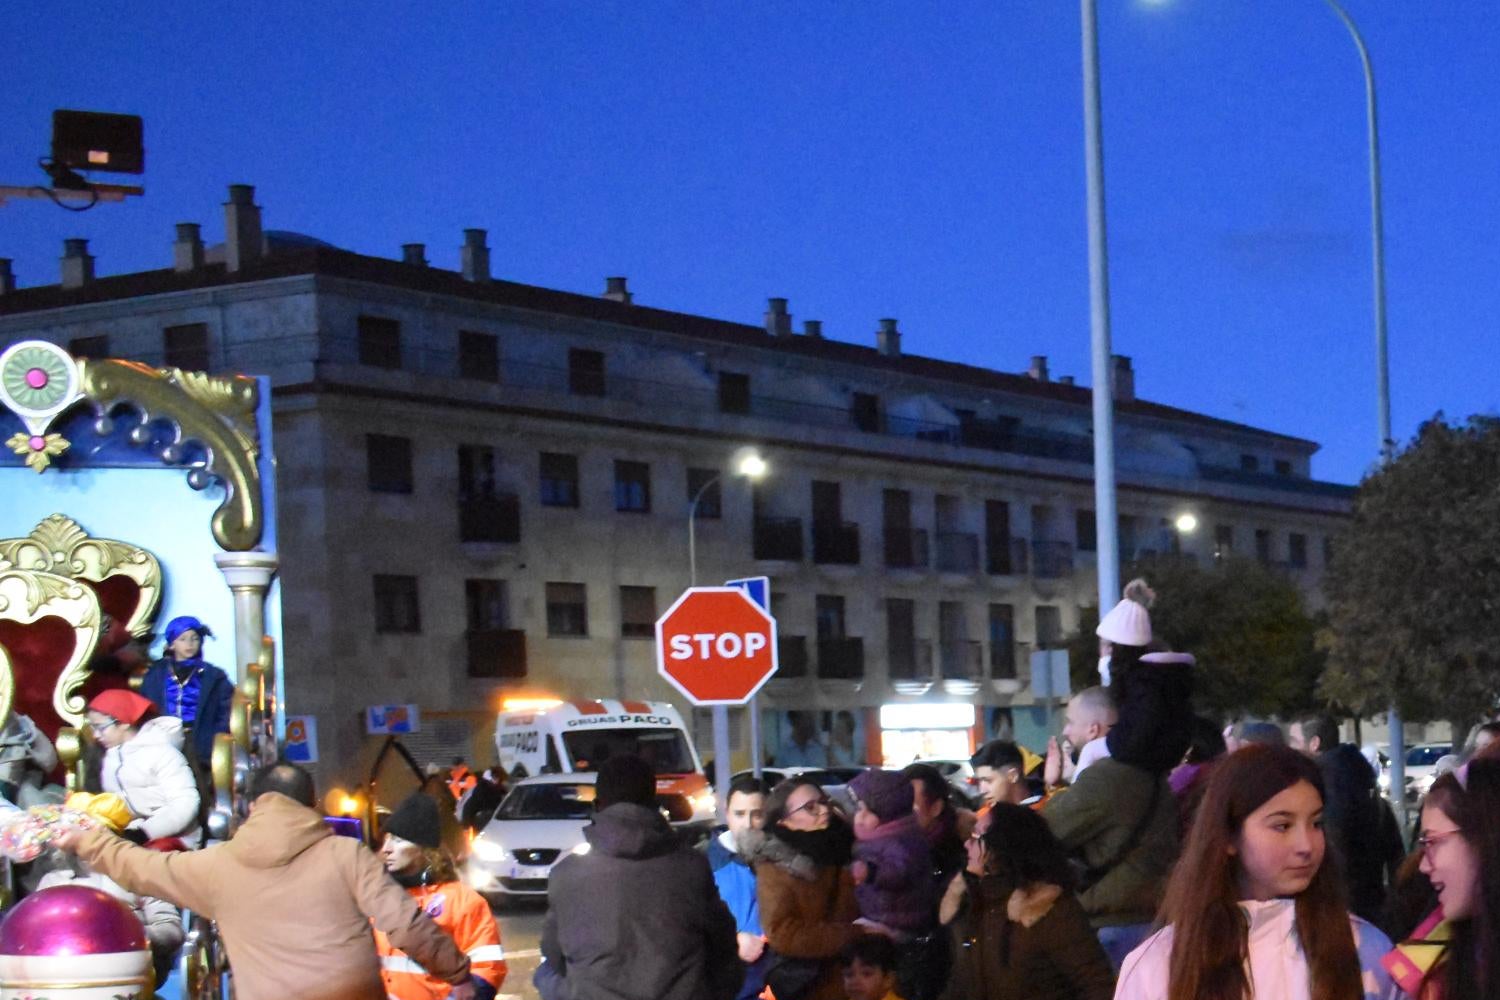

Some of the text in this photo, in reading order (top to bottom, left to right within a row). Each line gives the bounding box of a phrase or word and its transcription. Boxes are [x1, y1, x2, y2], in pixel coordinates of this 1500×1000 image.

[669, 631, 766, 660] STOP
[566, 711, 672, 728] GRUAS PACO
